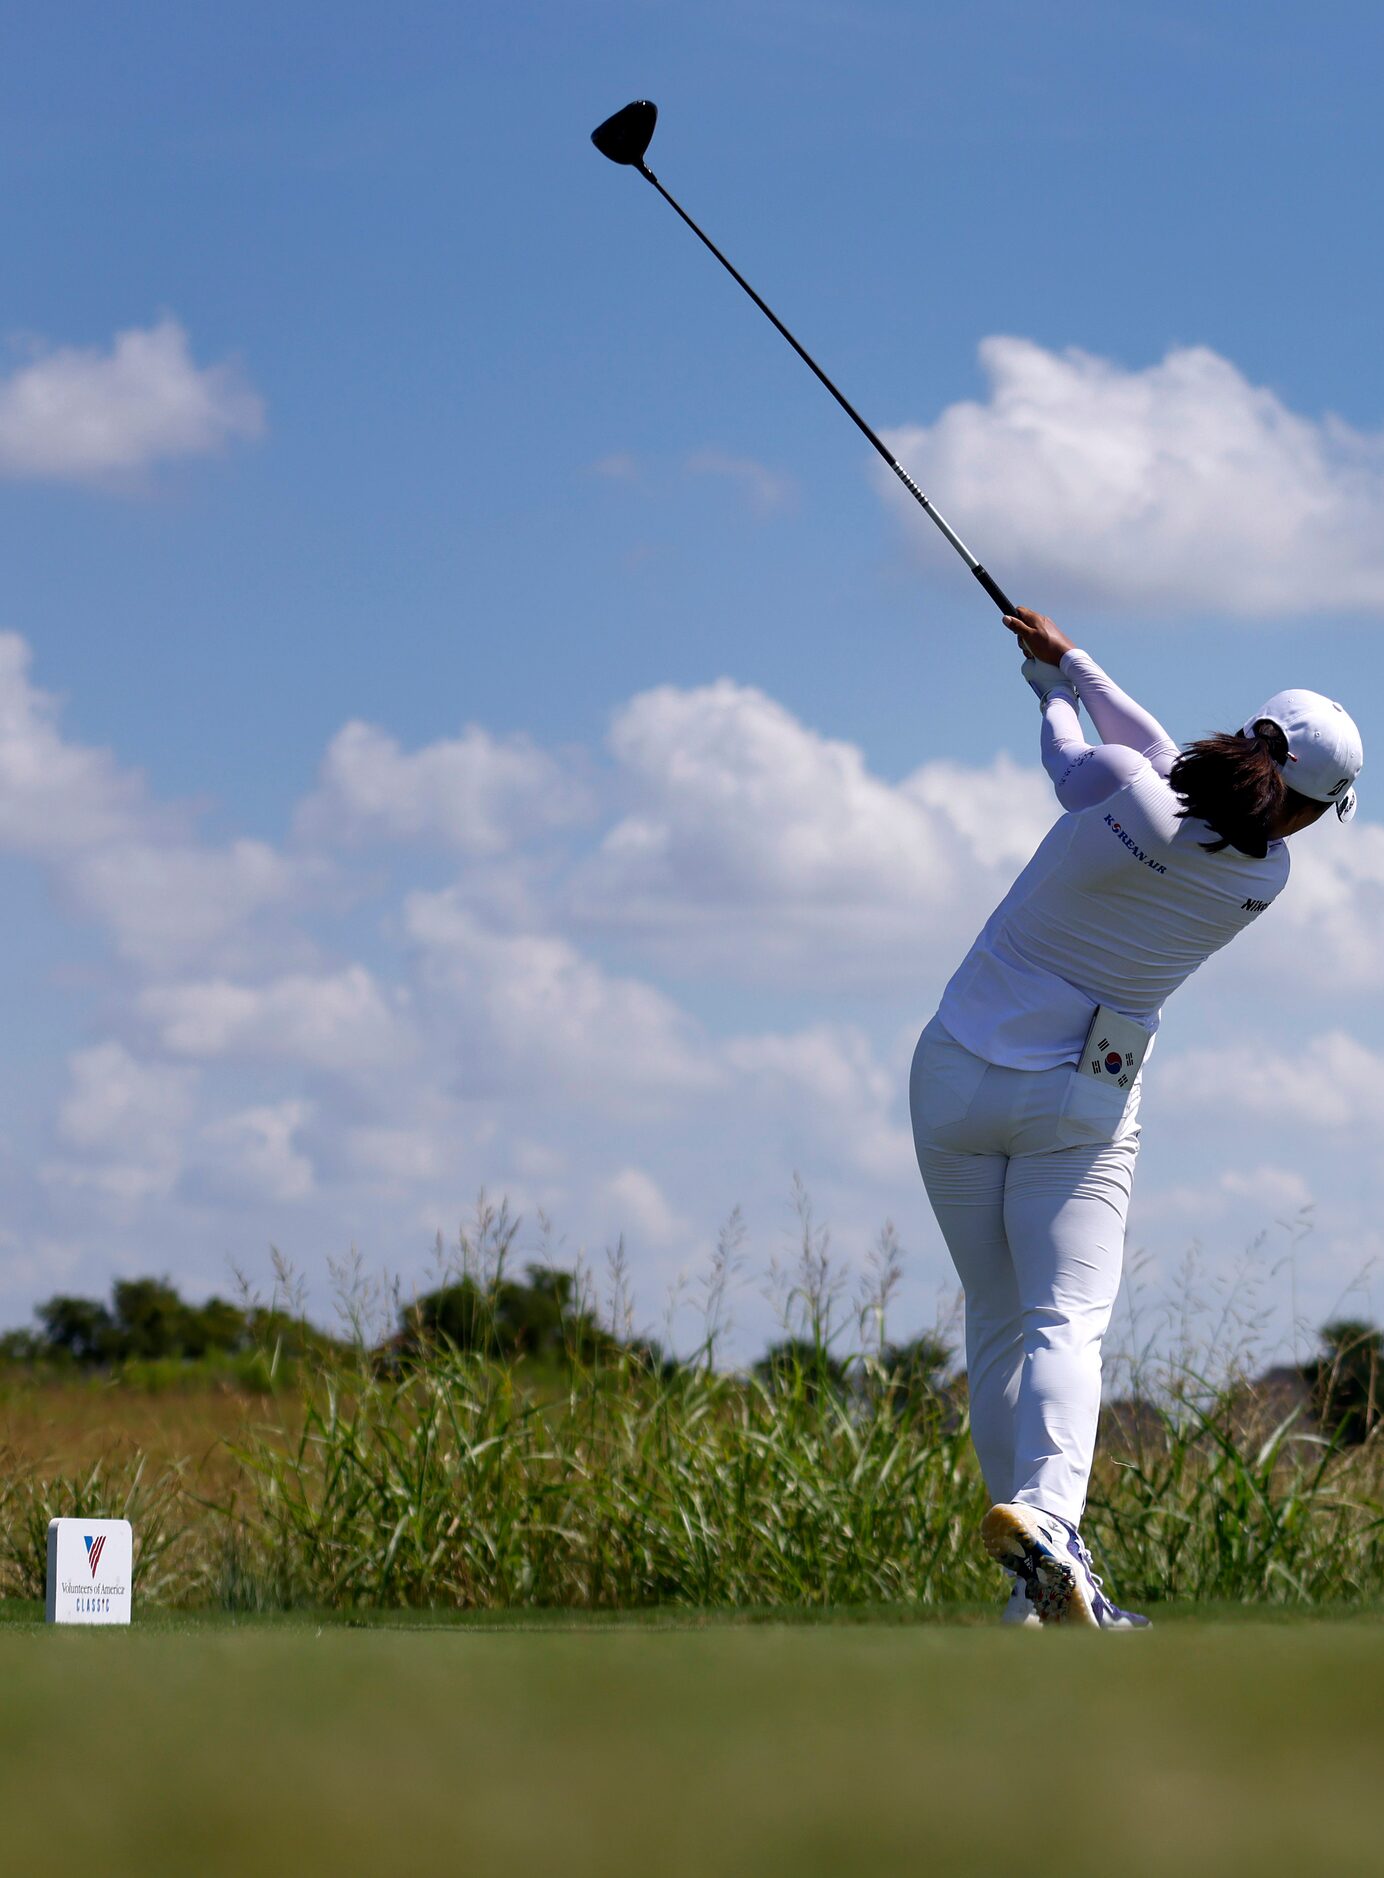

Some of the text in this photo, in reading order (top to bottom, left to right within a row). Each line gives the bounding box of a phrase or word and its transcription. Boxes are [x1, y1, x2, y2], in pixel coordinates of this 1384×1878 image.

[1144, 860, 1167, 874] AIR
[62, 1582, 125, 1595] Volunteers of America
[76, 1598, 109, 1612] CLASSIC
